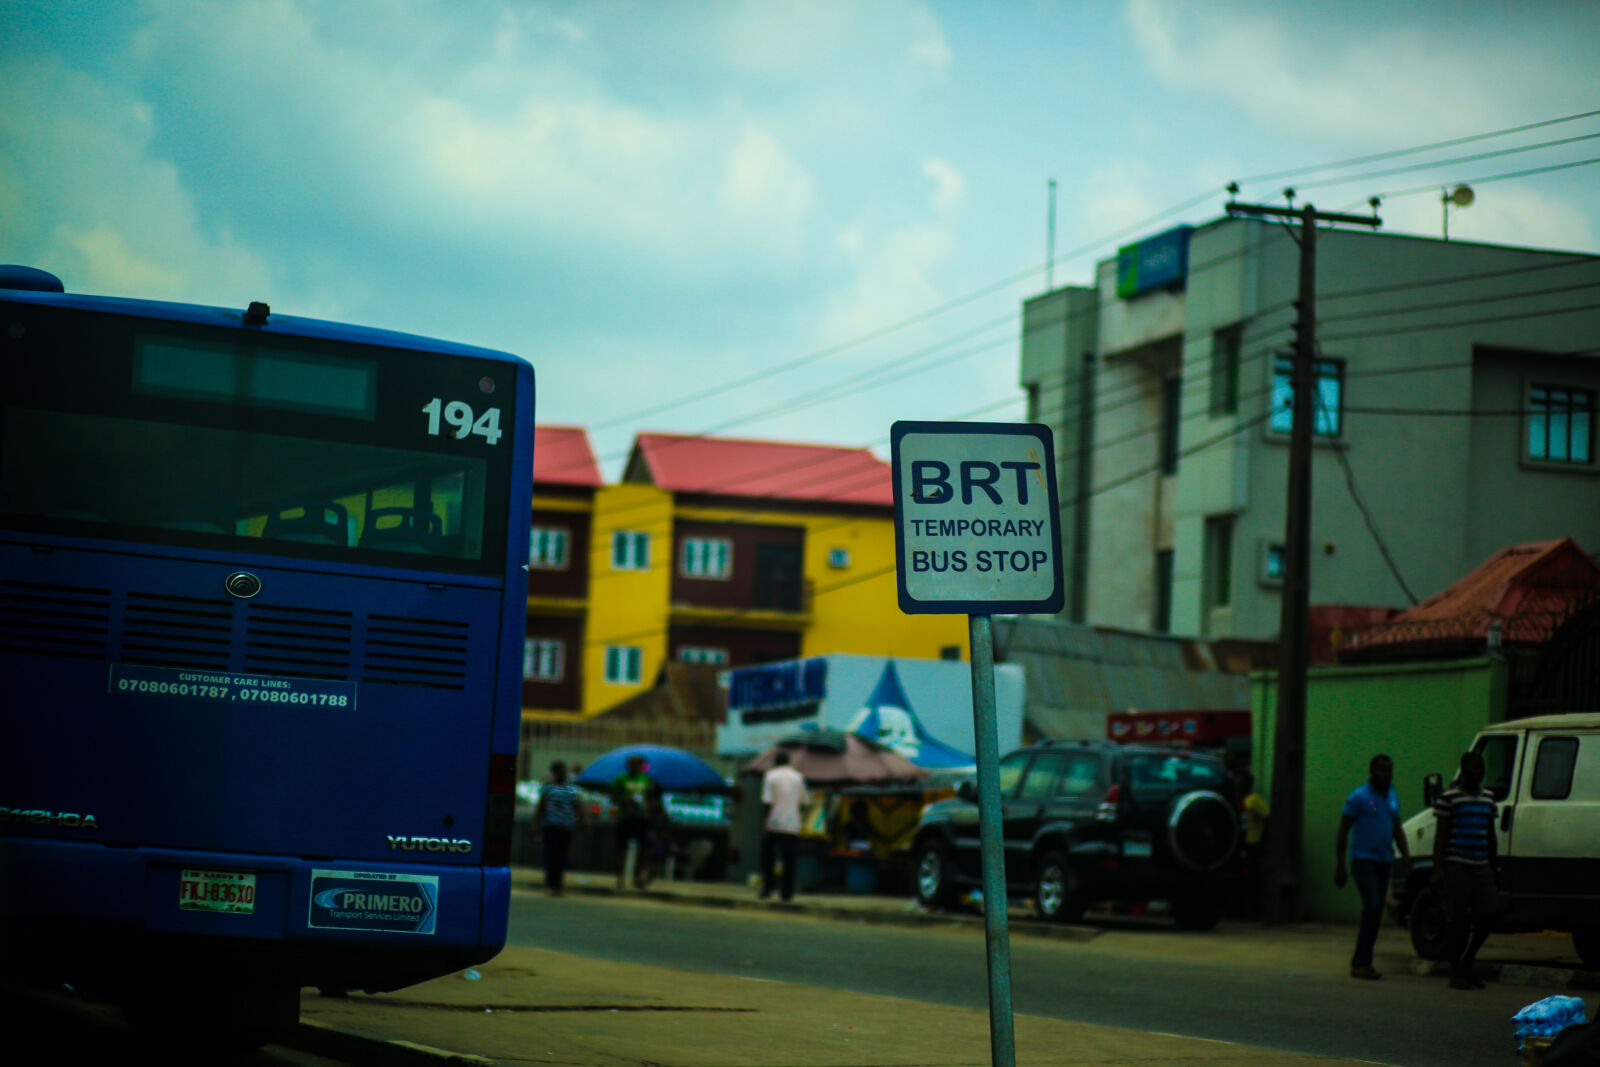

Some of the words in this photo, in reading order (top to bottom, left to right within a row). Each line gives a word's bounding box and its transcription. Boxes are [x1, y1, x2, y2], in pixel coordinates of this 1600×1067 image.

[422, 398, 502, 445] 194
[911, 460, 1041, 505] BRT
[911, 519, 1044, 537] TEMPORARY
[912, 550, 968, 572] BUS
[976, 550, 1047, 572] STOP
[179, 673, 231, 684] CUSTOMER
[233, 677, 259, 687] CARE
[261, 679, 291, 689] LINES:
[239, 689, 348, 707] 07080601788
[386, 835, 473, 854] YUTONG
[353, 872, 387, 880] OPERATED
[342, 892, 424, 913] PRIMERO
[329, 909, 363, 921] Transport
[364, 911, 392, 921] Services
[393, 913, 420, 922] Limited
